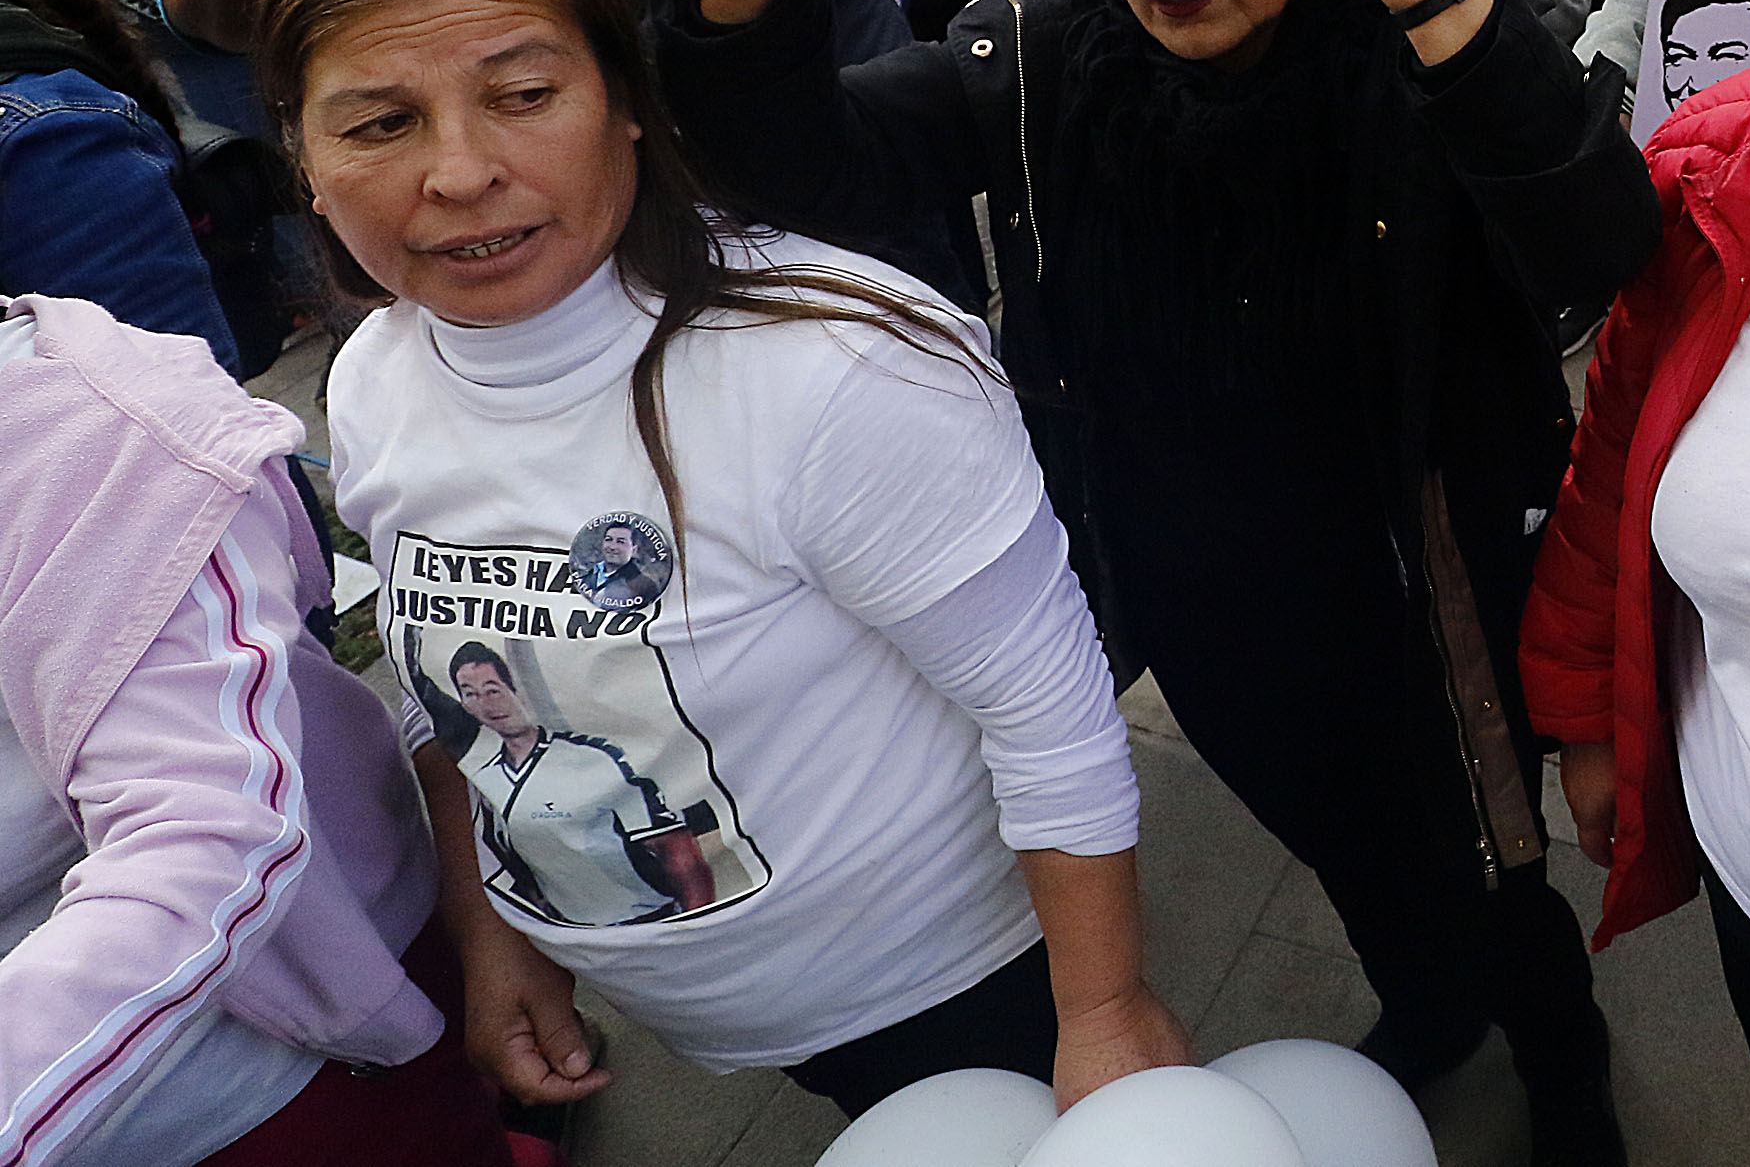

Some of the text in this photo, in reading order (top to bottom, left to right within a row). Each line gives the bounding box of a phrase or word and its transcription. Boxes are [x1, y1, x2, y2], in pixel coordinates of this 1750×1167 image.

[586, 514, 667, 561] VERDAD Y JUSTICIA
[412, 547, 582, 595] LEYES HA
[571, 572, 594, 597] PARA
[395, 588, 648, 639] JUSTICIA NO
